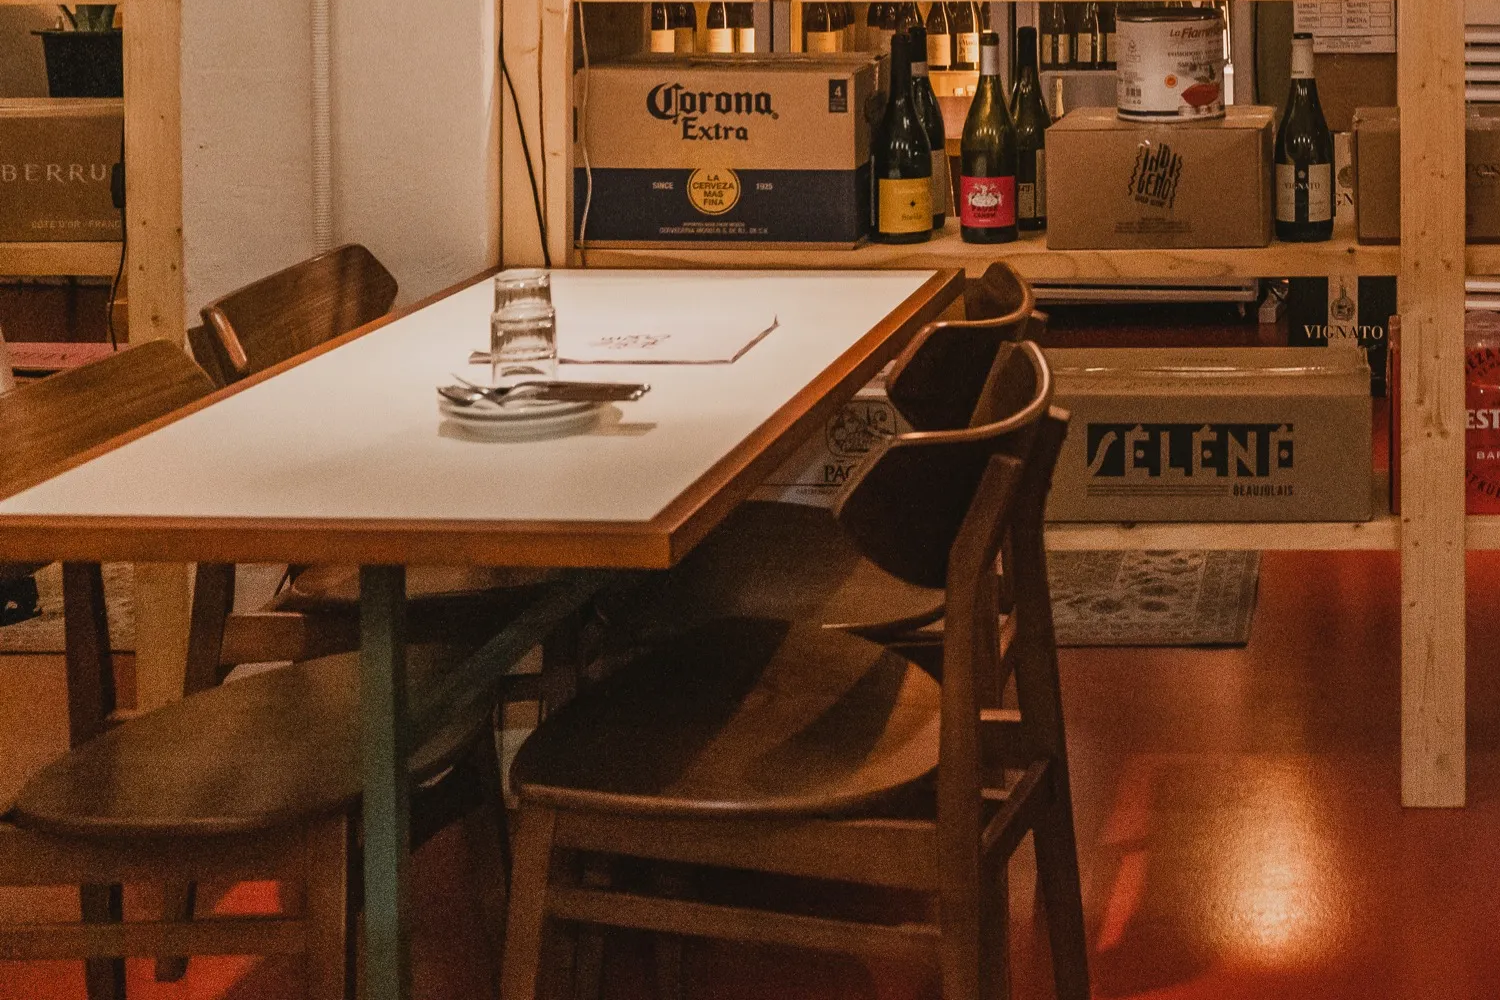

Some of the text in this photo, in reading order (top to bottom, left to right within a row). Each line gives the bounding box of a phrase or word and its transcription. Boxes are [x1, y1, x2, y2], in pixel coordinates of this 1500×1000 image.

[646, 81, 774, 125] Corona
[682, 116, 749, 141] Extra
[652, 181, 773, 190] SINCE CERVEZA 1925
[1285, 182, 1320, 190] VIGNATO
[703, 190, 724, 198] MAS
[703, 198, 724, 206] FINA
[1303, 325, 1384, 340] VIGNATO
[1232, 483, 1294, 497] BEAUJOLAIS
